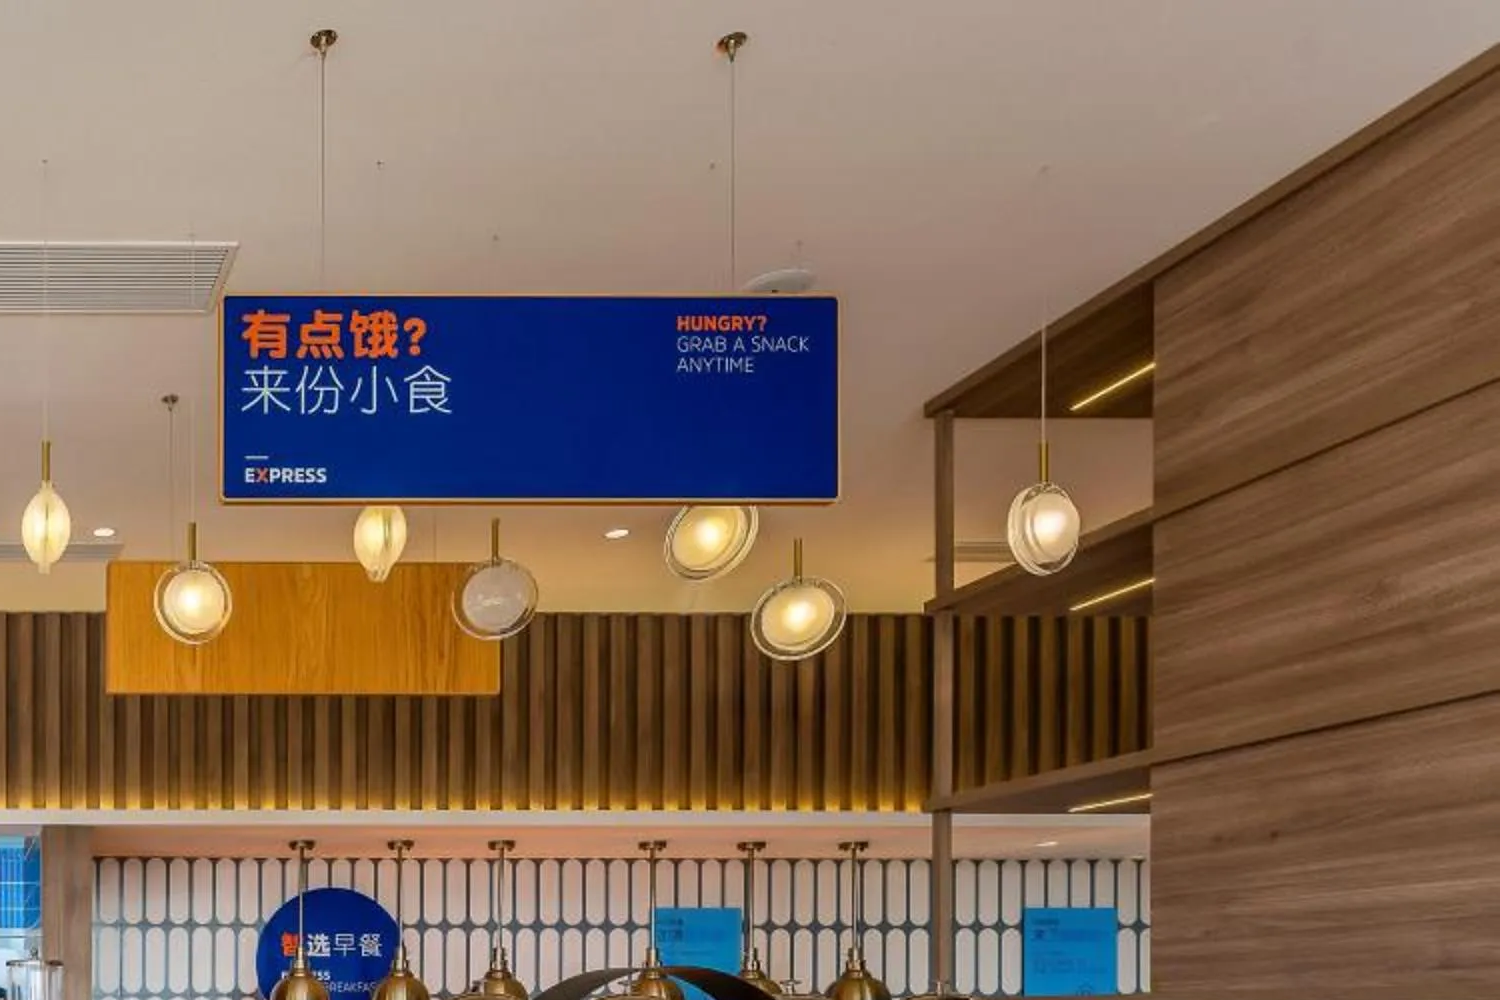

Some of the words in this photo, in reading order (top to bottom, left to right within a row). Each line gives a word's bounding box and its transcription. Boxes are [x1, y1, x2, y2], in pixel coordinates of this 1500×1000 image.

[676, 315, 768, 332] HUNGRY?
[676, 335, 728, 353] GRAB
[733, 335, 746, 352] A
[751, 335, 810, 353] SNACK
[677, 357, 756, 374] ANYTIME
[241, 365, 452, 414] 来份小食
[245, 467, 328, 484] EXPRESS
